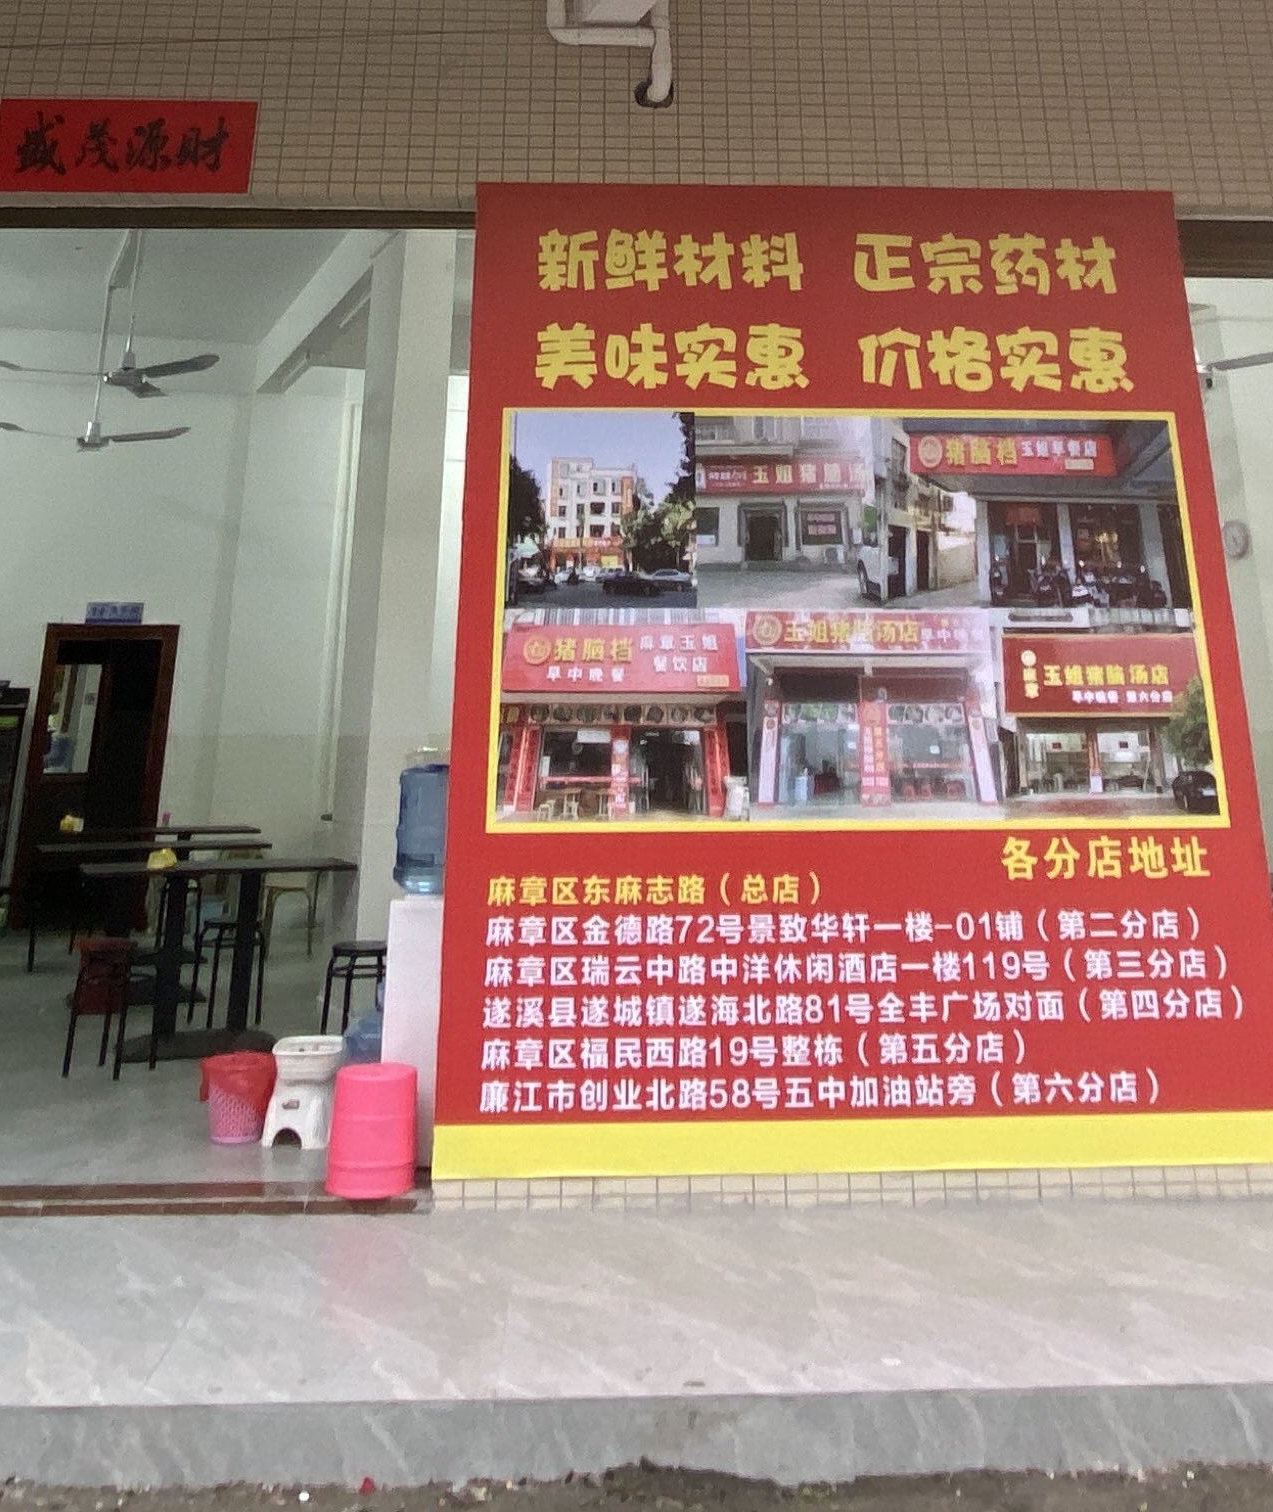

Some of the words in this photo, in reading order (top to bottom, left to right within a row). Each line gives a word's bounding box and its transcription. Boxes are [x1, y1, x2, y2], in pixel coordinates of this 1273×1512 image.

[537, 228, 804, 292] 新鲜材料
[853, 232, 1118, 296] 正宗药材
[533, 322, 810, 391] 美味实惠
[858, 325, 1135, 394] 价格实惠
[1002, 836, 1211, 880] 各分店地址
[487, 872, 822, 906] 麻章区东麻志路（总店）
